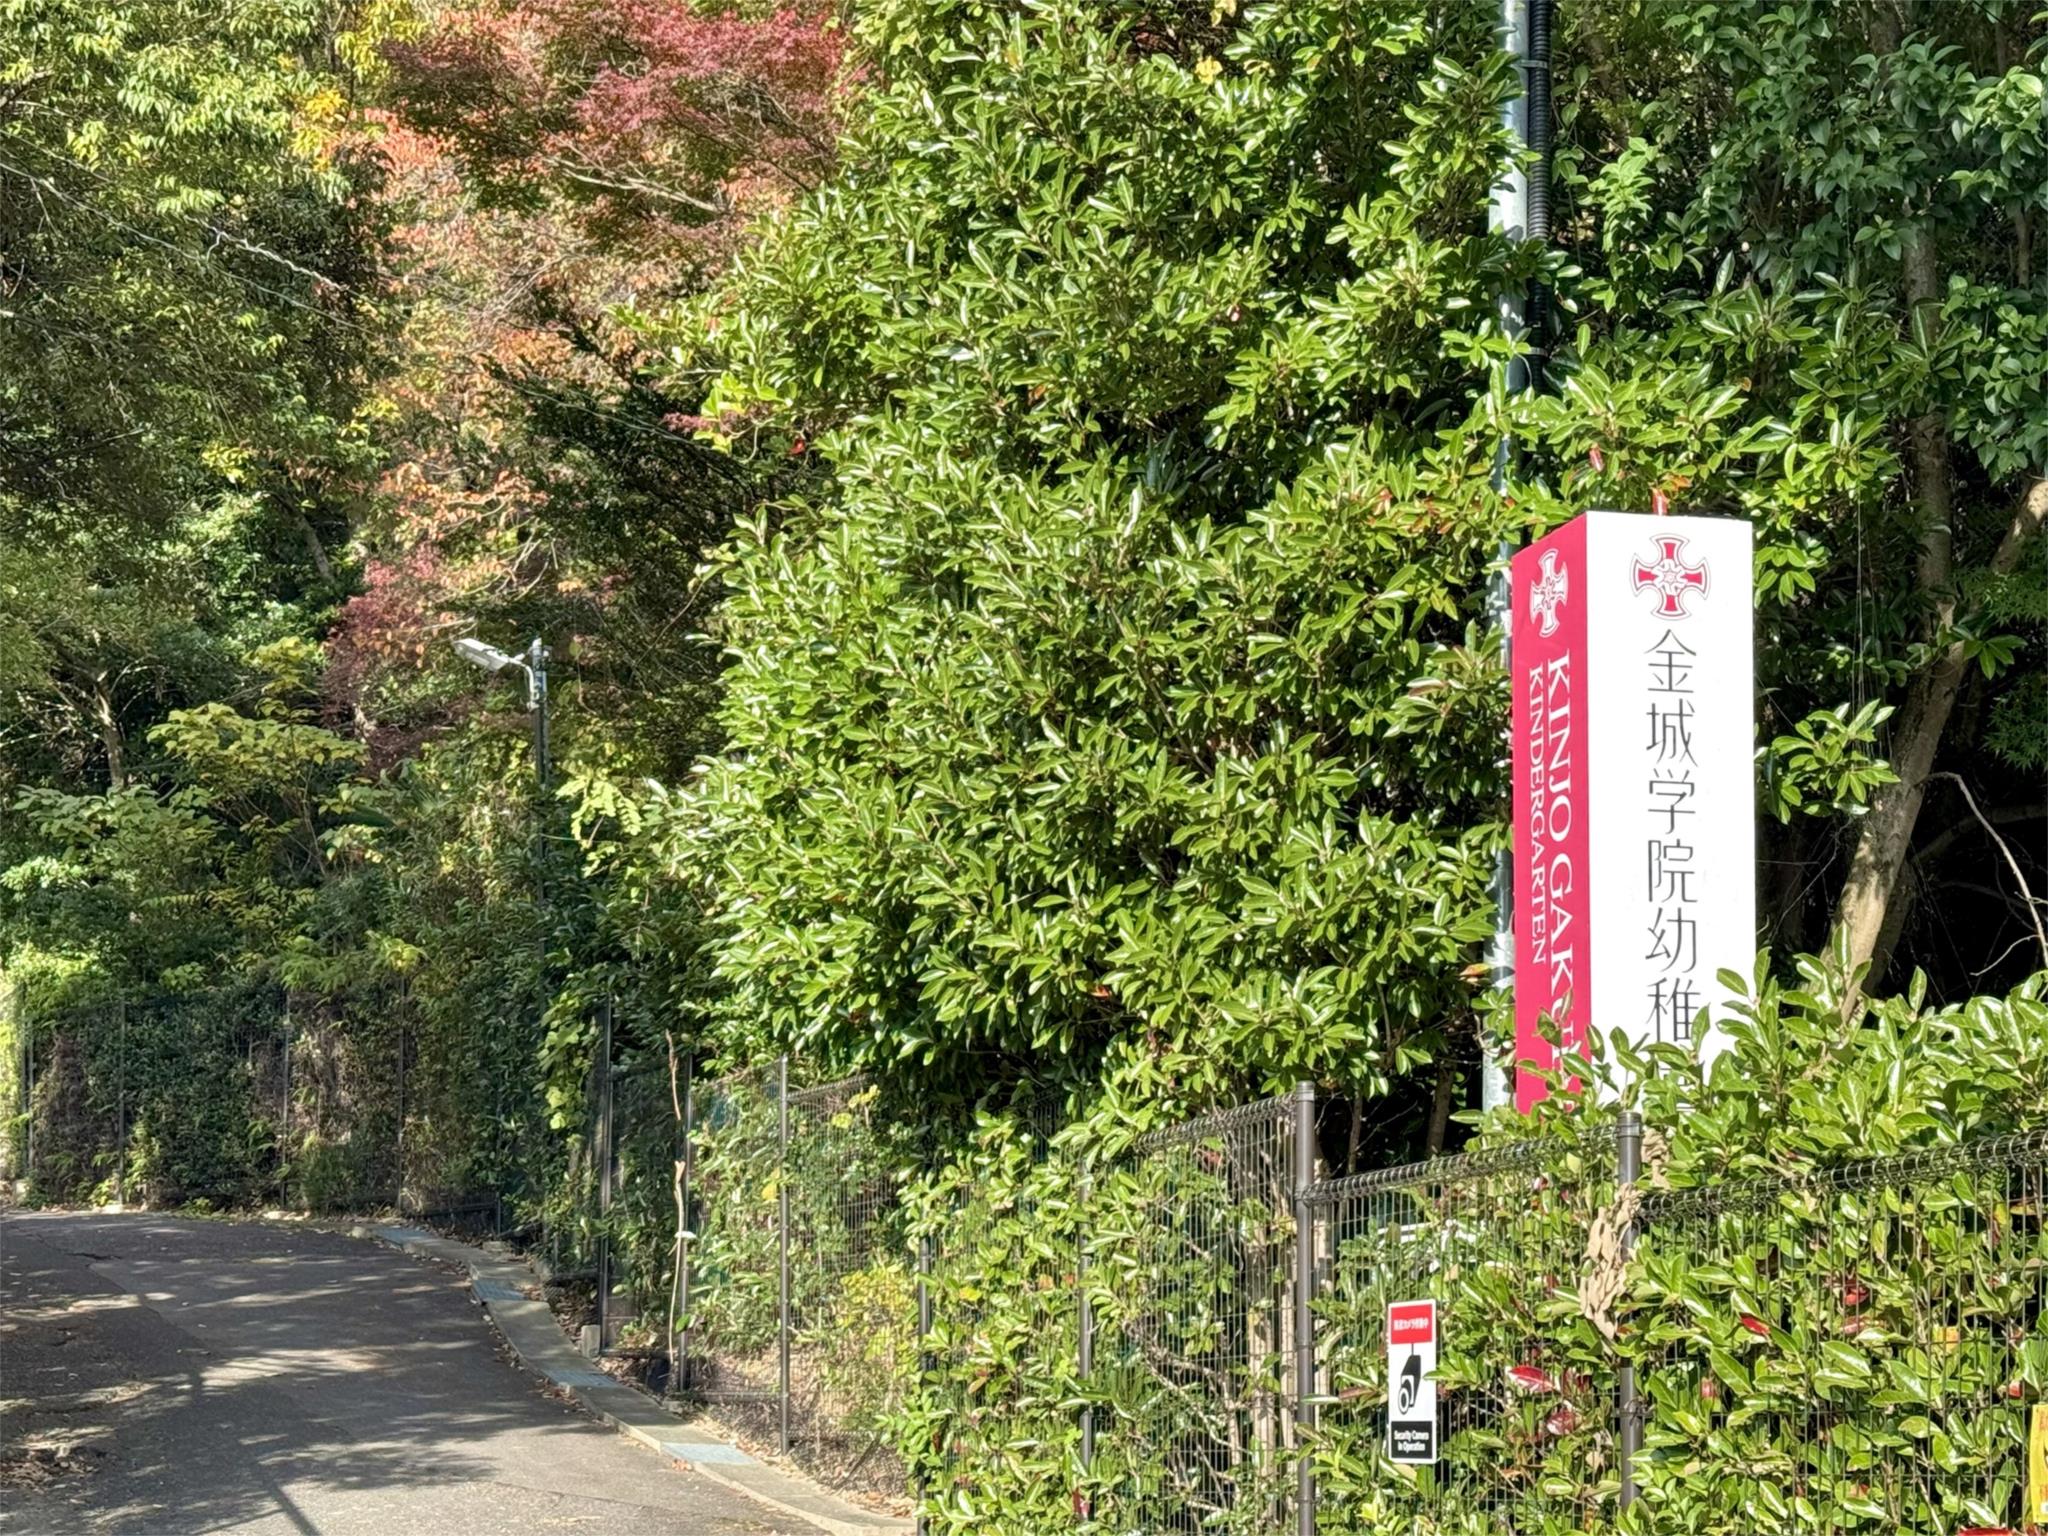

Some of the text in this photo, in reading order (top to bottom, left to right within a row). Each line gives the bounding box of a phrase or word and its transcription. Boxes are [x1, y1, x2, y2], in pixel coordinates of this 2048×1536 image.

[1528, 662, 1547, 965] KINDERGARTEN
[1547, 648, 1573, 842] KINJO
[1644, 628, 1701, 1108] 金城学院幼稚
